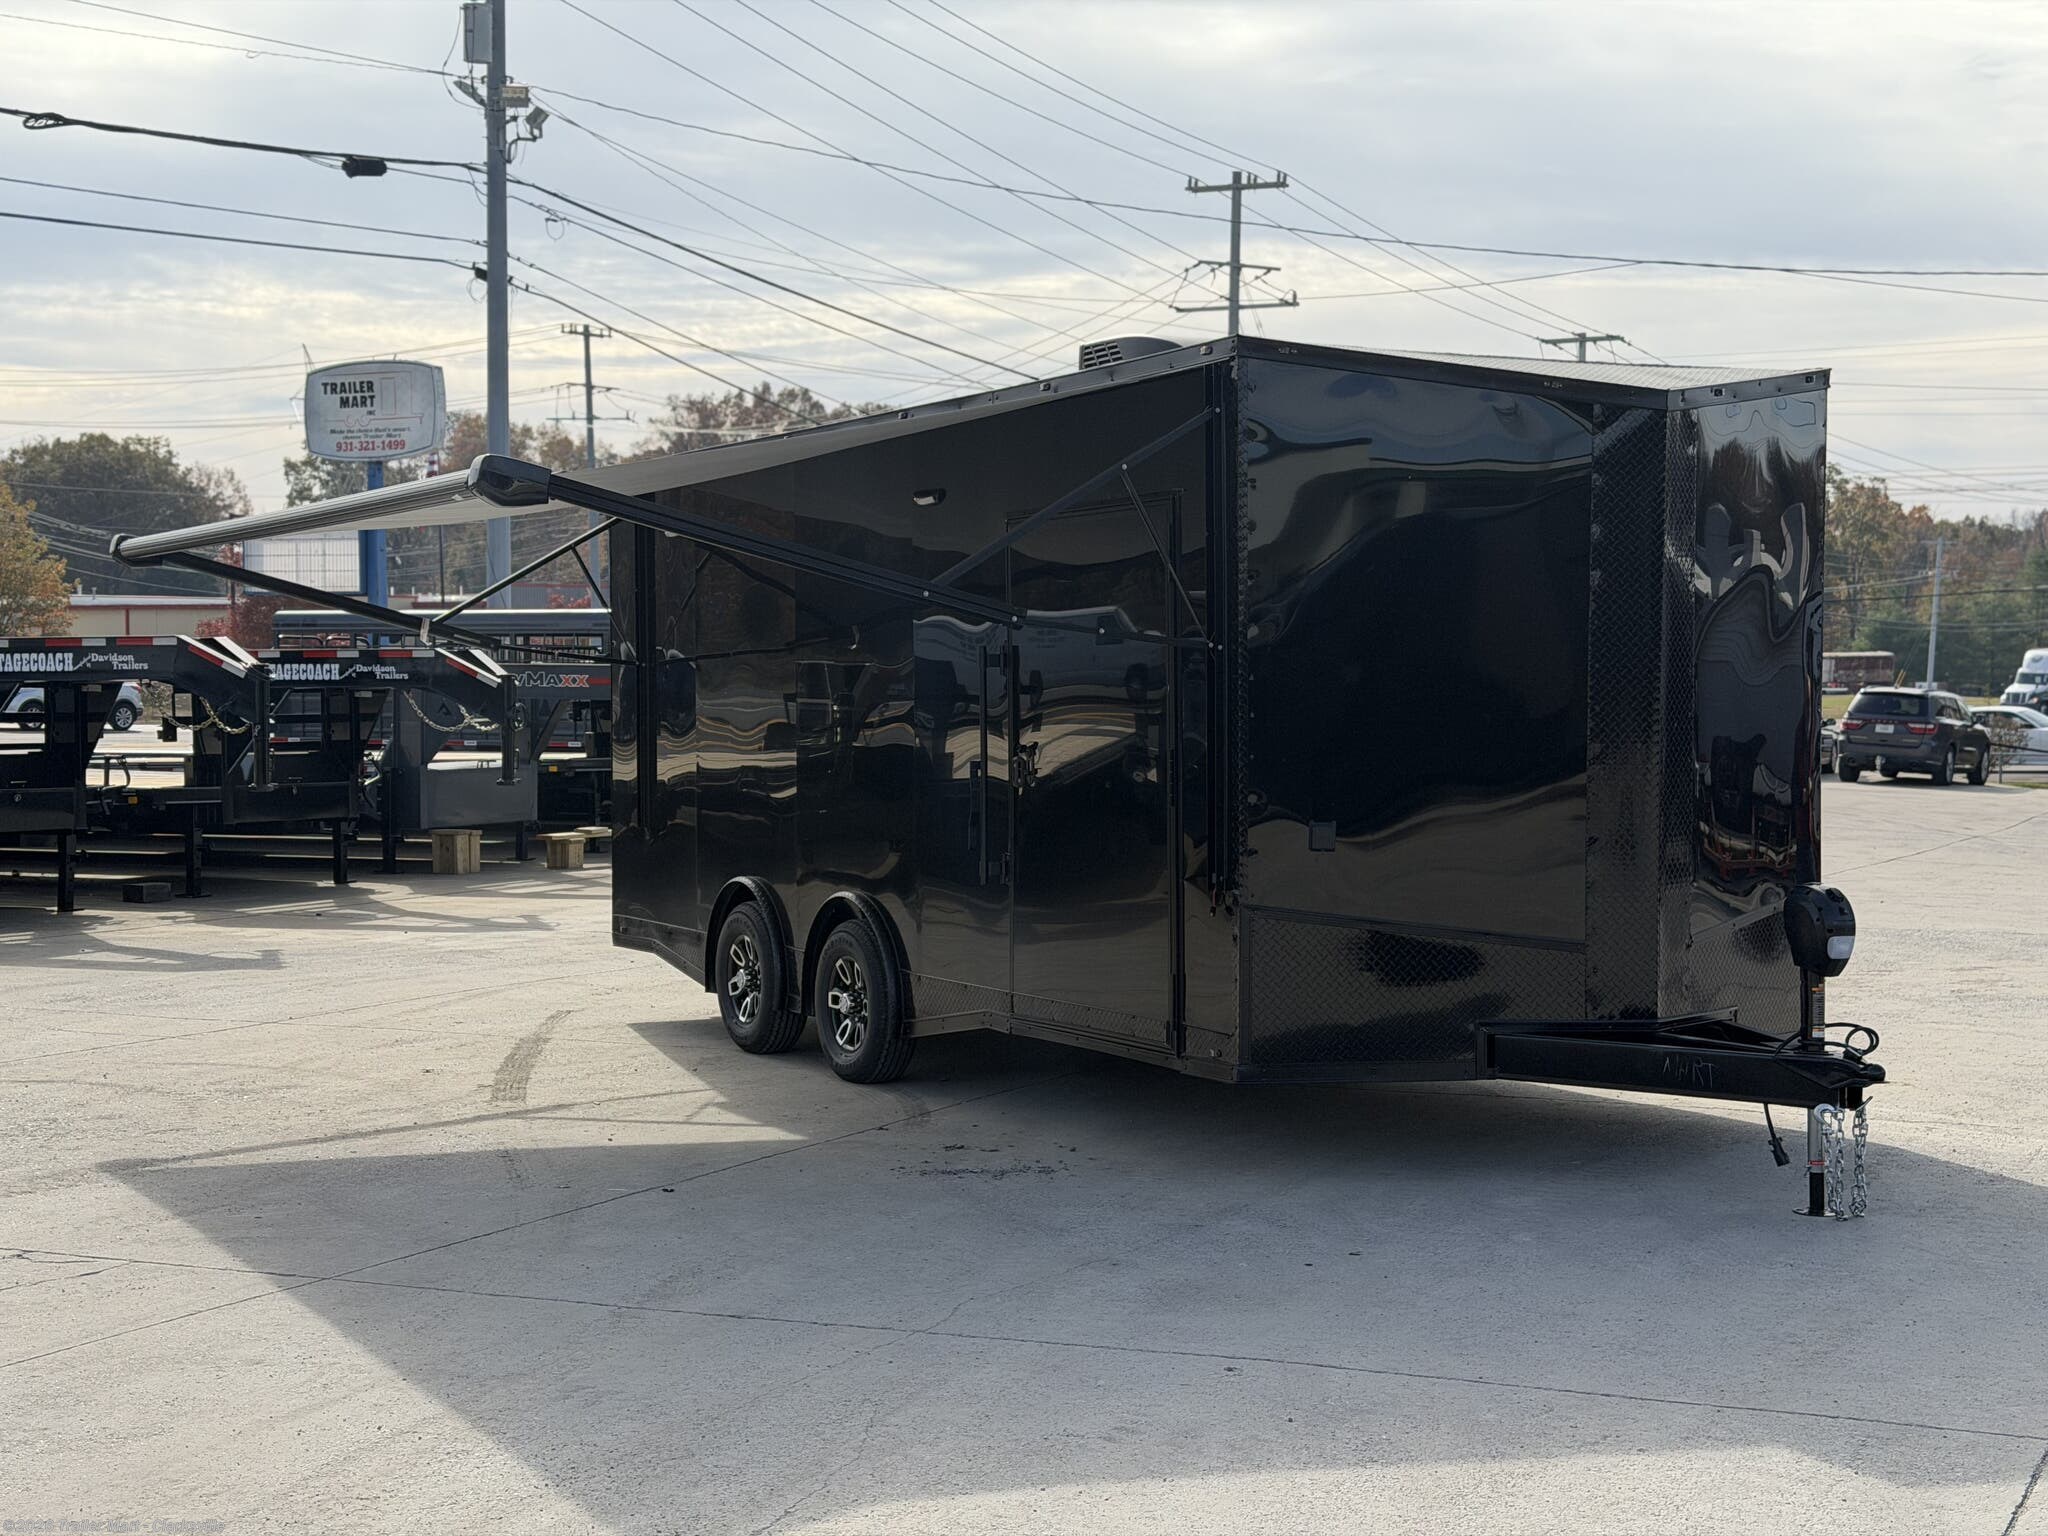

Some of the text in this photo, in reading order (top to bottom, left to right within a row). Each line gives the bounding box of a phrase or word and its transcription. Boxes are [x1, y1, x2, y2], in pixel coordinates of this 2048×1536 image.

[321, 381, 374, 395] TRAILER
[339, 394, 376, 409] MART
[336, 439, 406, 452] 931-321-1499
[91, 652, 134, 662] Davidson
[112, 660, 149, 671] Trailers
[355, 664, 396, 673] Davidson
[375, 670, 409, 680] Trailers
